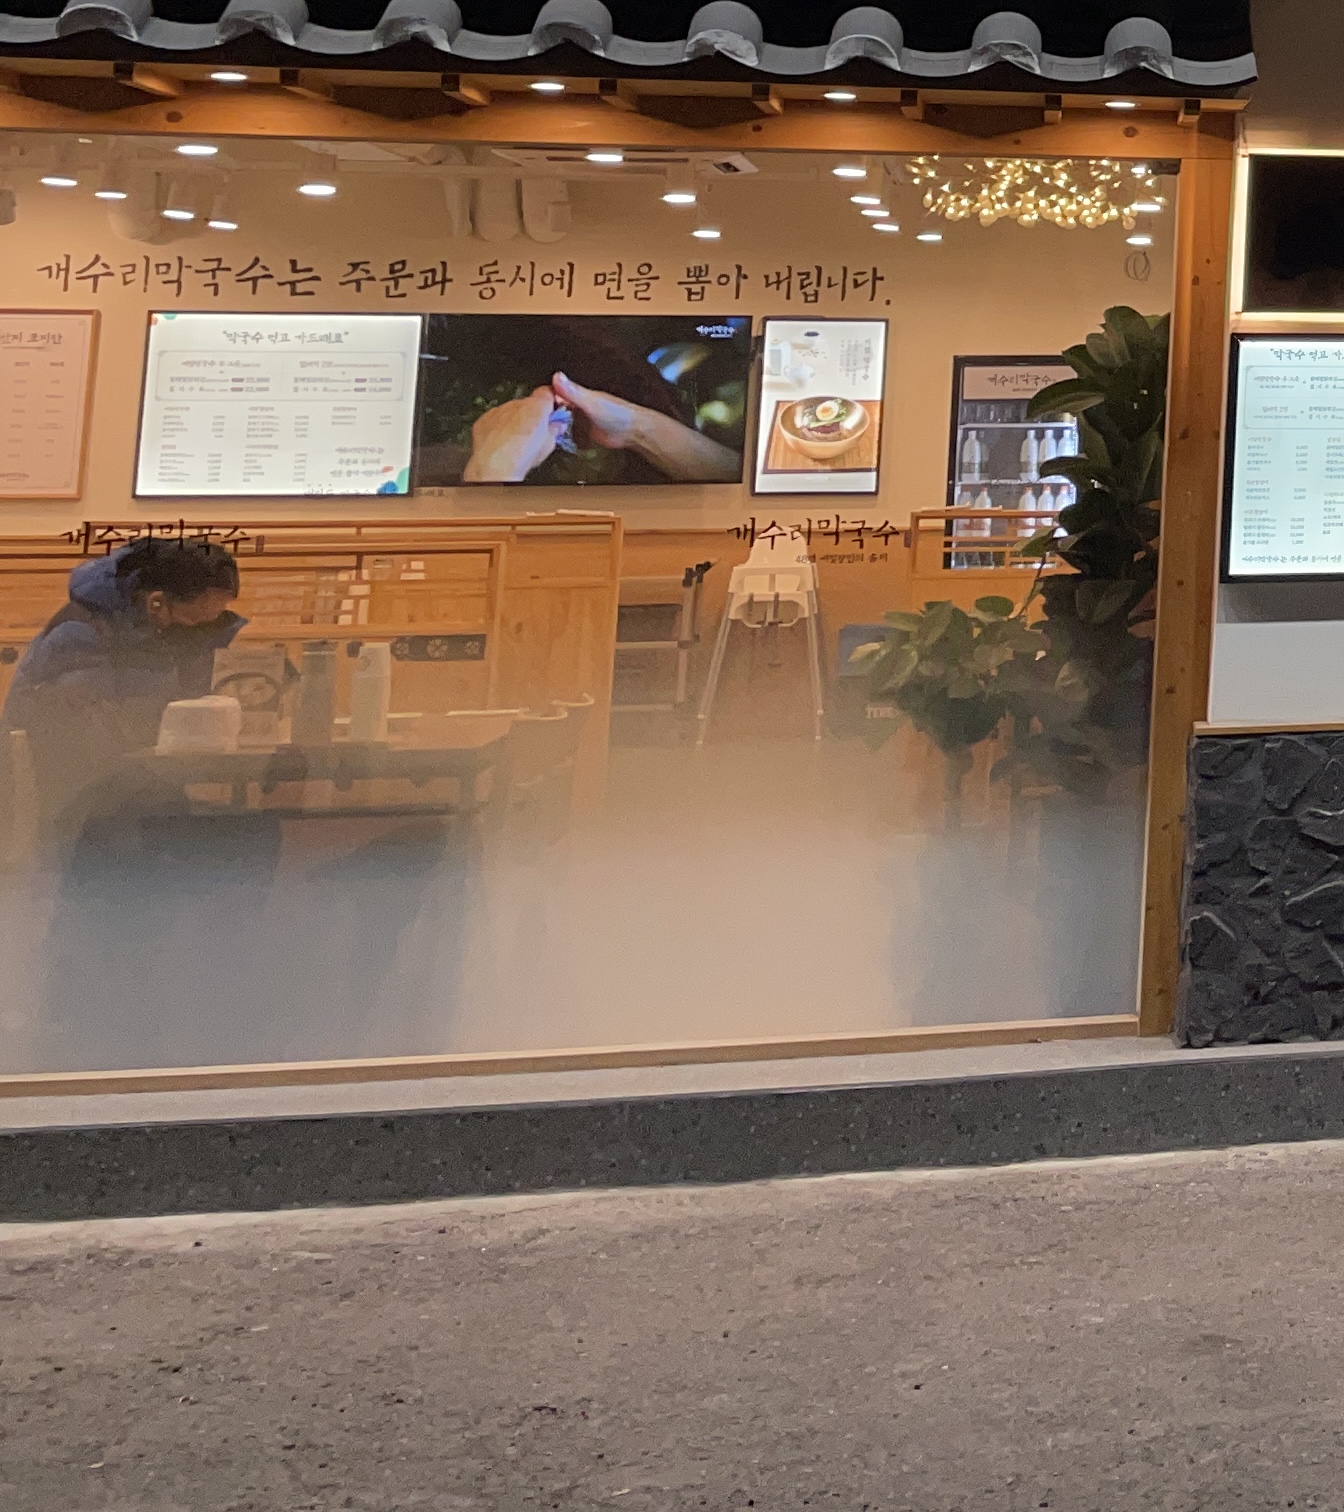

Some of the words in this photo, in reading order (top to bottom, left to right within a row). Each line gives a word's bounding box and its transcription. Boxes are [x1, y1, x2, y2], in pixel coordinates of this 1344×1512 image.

[36, 253, 323, 299] 개수리막국수는
[338, 258, 454, 299] 주문과
[468, 260, 576, 301] 동시에
[593, 262, 661, 301] 면을
[676, 262, 749, 302] 뽑아
[763, 264, 893, 306] 내립니다.
[726, 514, 900, 550] 개수리막국수
